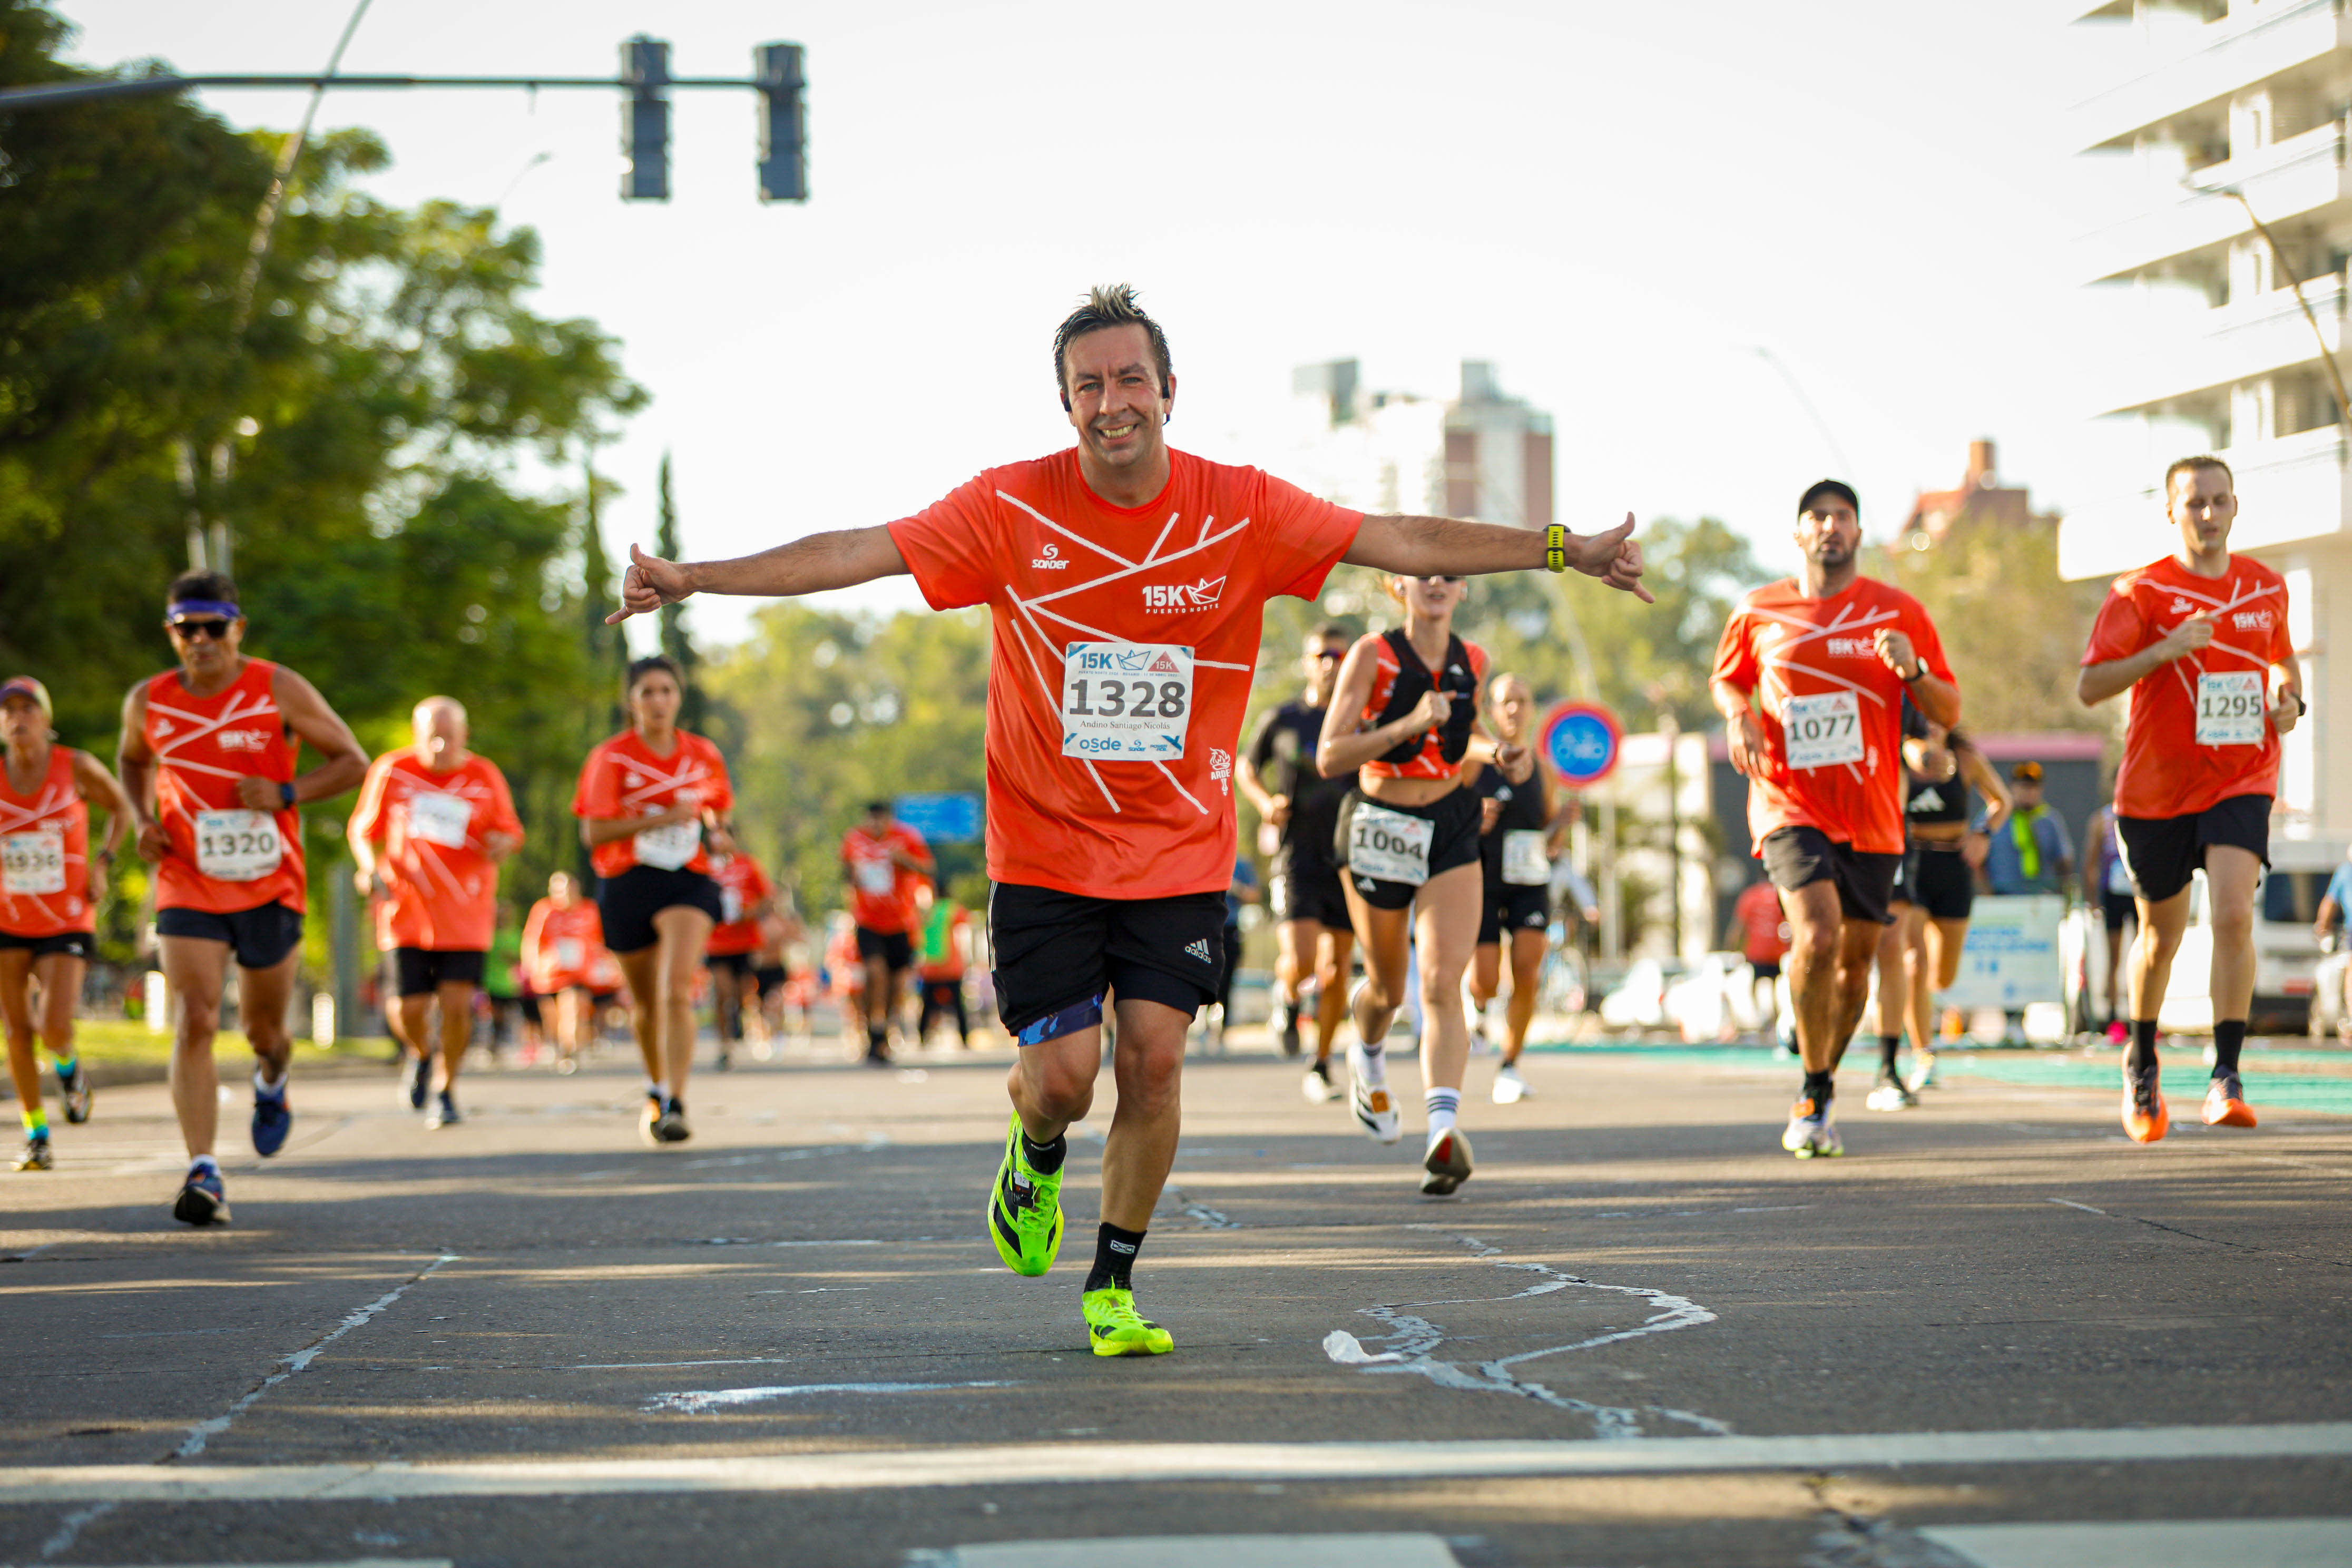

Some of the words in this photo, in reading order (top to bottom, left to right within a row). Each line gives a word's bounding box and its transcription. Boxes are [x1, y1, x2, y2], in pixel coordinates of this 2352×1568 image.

[1142, 585, 1186, 607] 15K
[1190, 603, 1219, 613] NORTE
[1080, 653, 1114, 669] 15K
[1155, 661, 1173, 670] 15K
[1070, 679, 1186, 718] 1328
[2201, 695, 2261, 718] 1295
[1110, 721, 1142, 731] Santiago
[1790, 713, 1856, 741] 1077
[1080, 737, 1122, 752] osde
[203, 832, 275, 857] 1320
[1355, 827, 1423, 860] 1004
[1185, 945, 1212, 964] adidas
